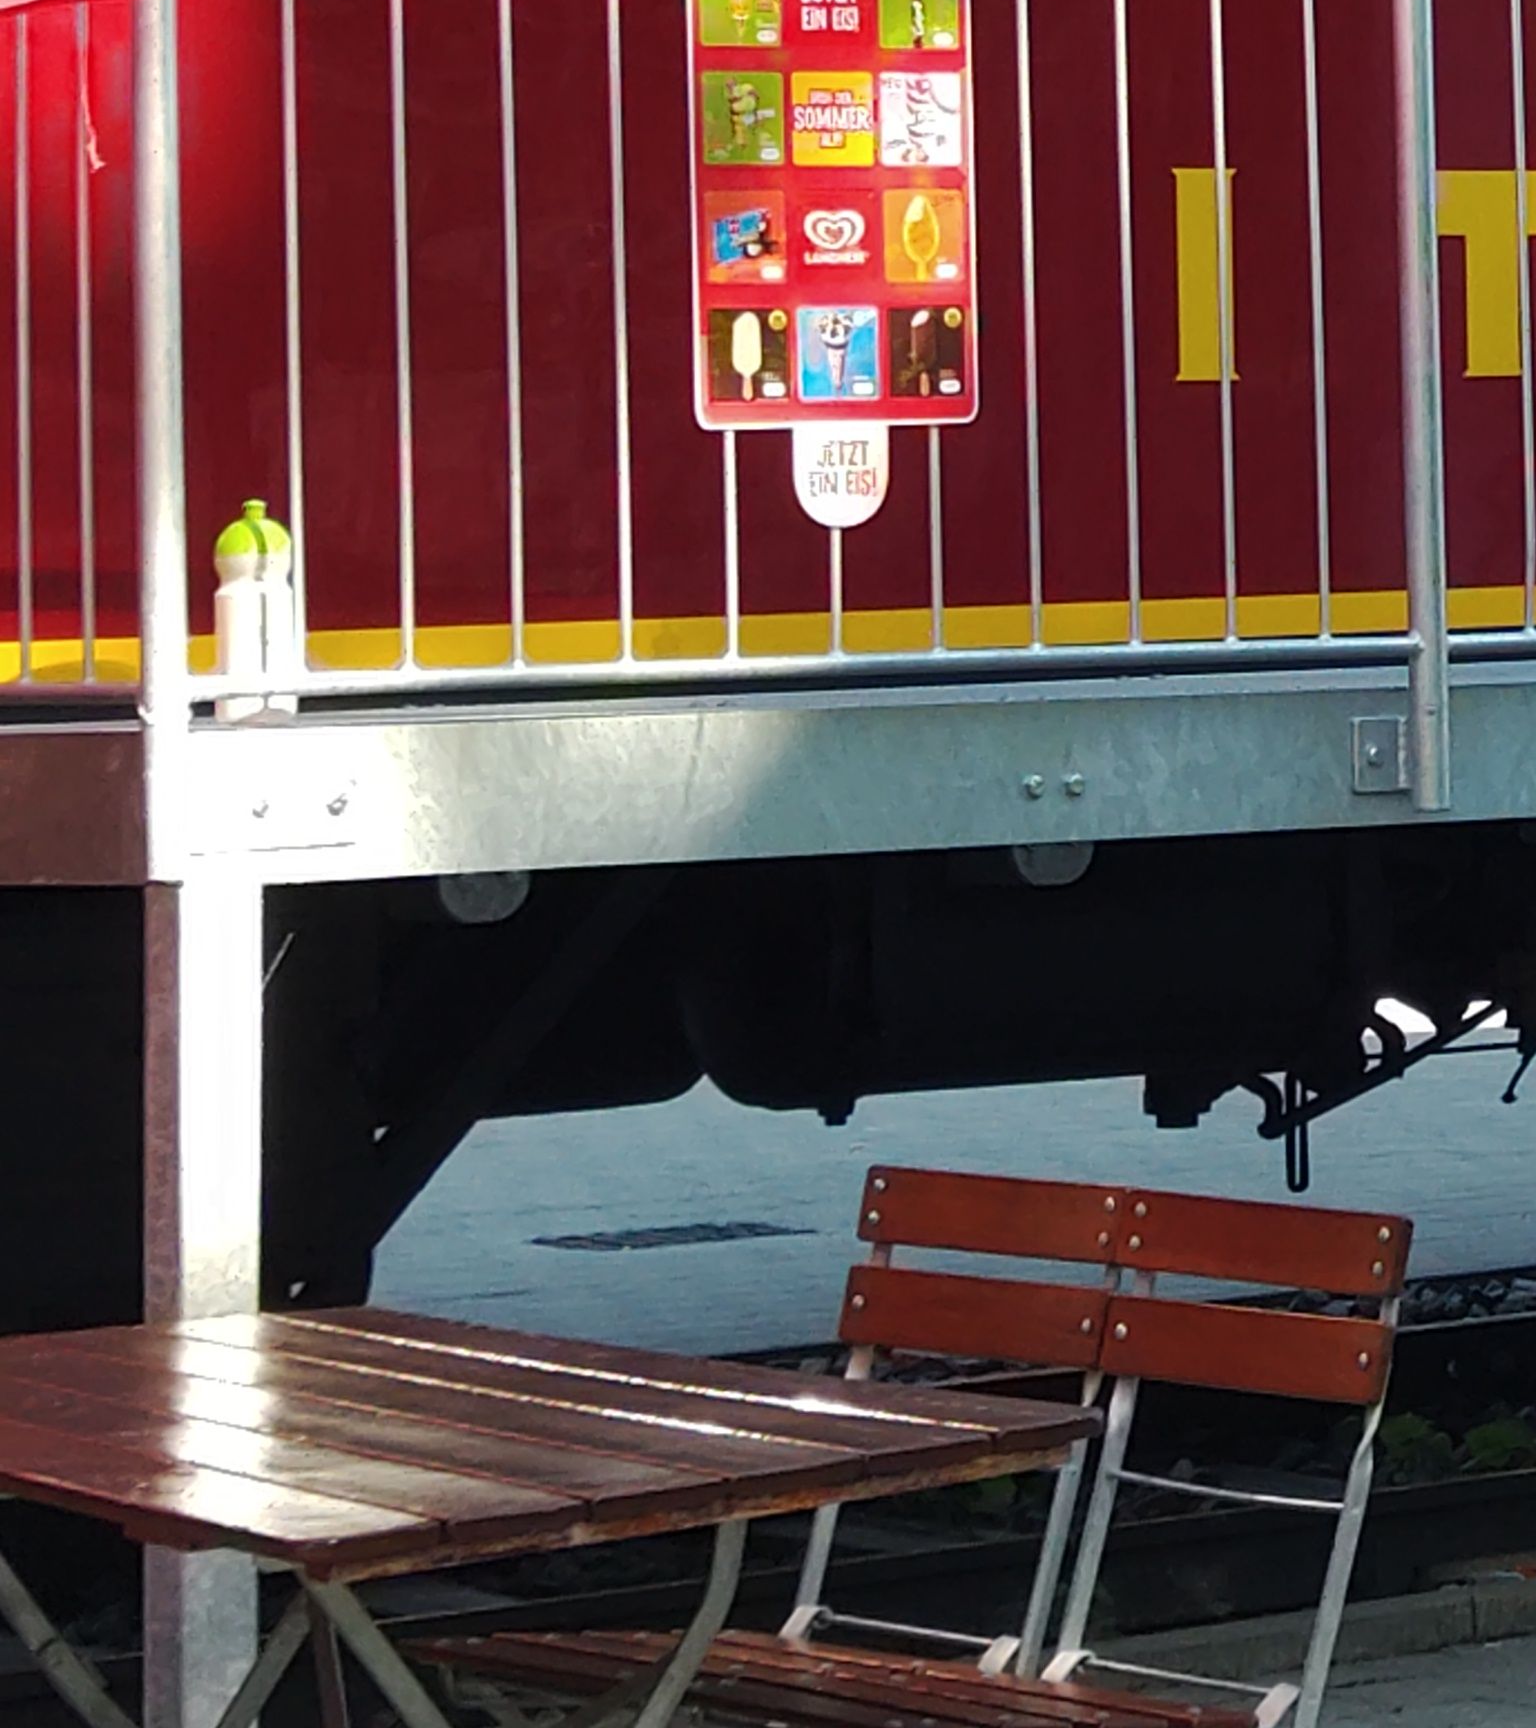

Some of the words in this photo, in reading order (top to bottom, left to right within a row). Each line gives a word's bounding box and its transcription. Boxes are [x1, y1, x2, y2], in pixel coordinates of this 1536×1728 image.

[801, 5, 827, 31] EIN
[831, 5, 861, 33] EIS!
[794, 105, 870, 131] SOMMER
[816, 439, 869, 467] JETZT
[808, 471, 839, 498] EIN
[845, 467, 877, 498] EIS!
